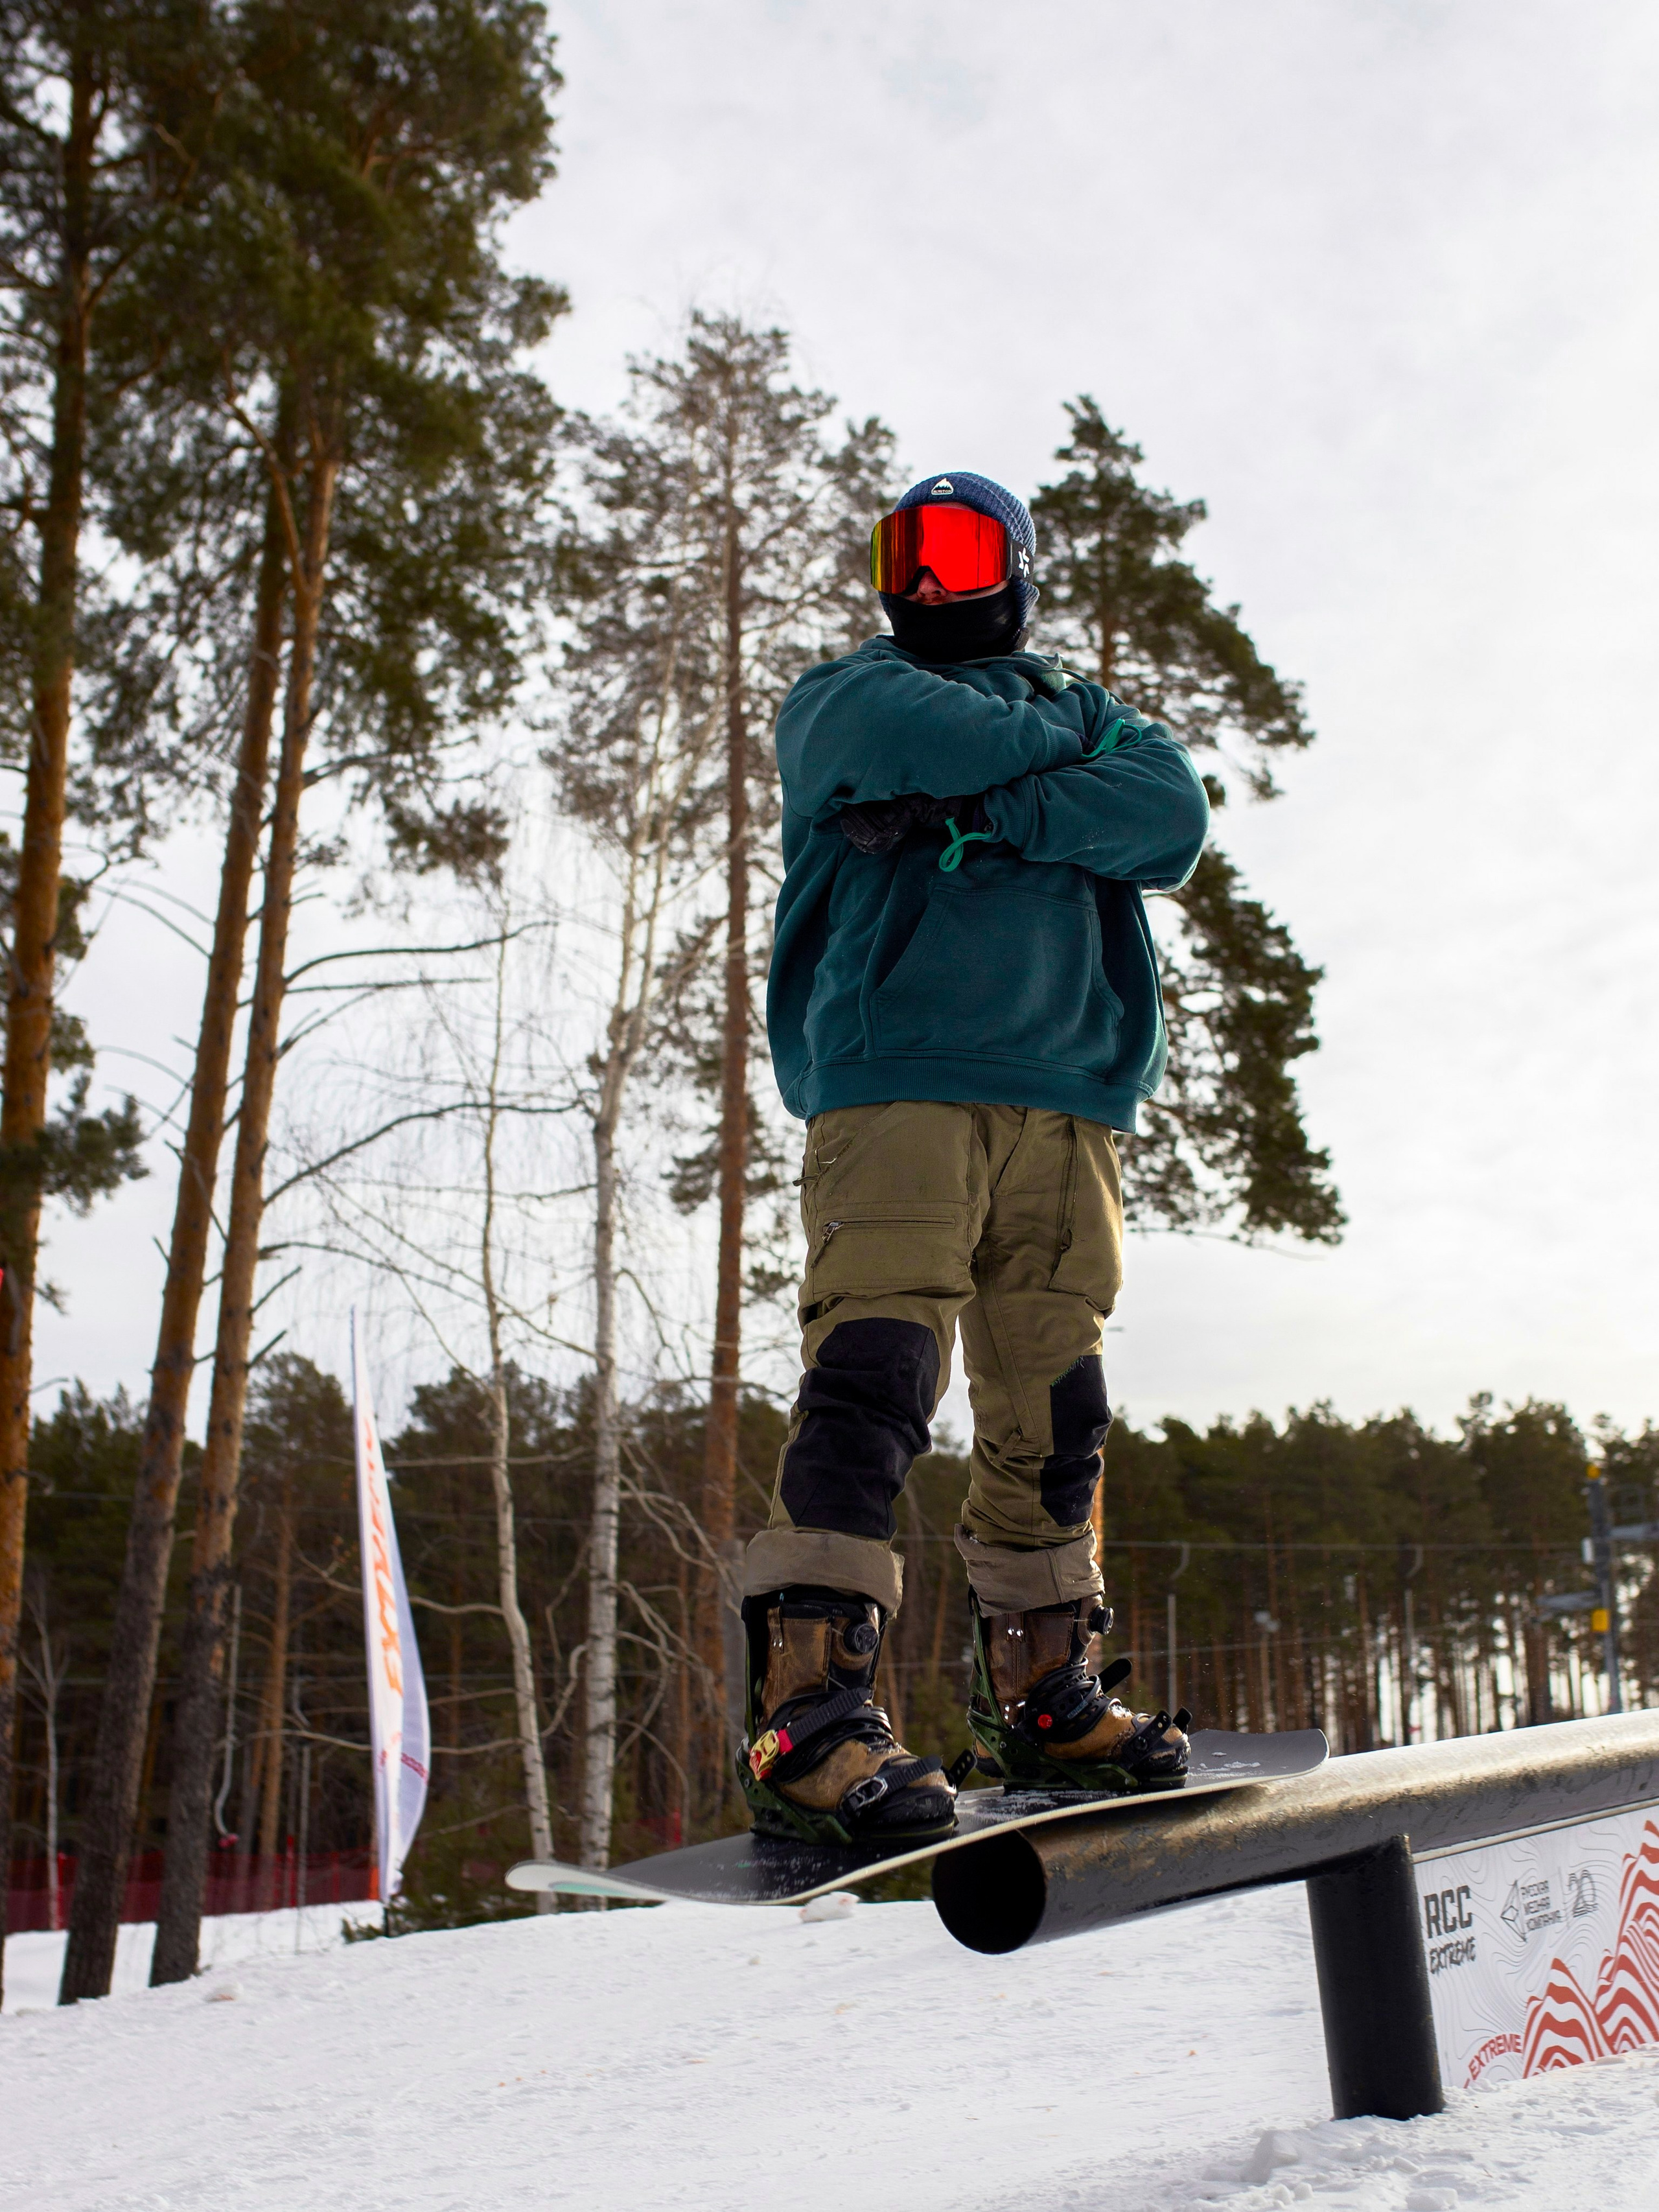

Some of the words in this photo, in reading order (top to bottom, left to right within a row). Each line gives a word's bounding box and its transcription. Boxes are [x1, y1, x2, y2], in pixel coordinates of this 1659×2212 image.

[1424, 1885, 1473, 1939] RCC
[1429, 1935, 1476, 1975] EXTREME
[1468, 2033, 1524, 2080] EXTREME
